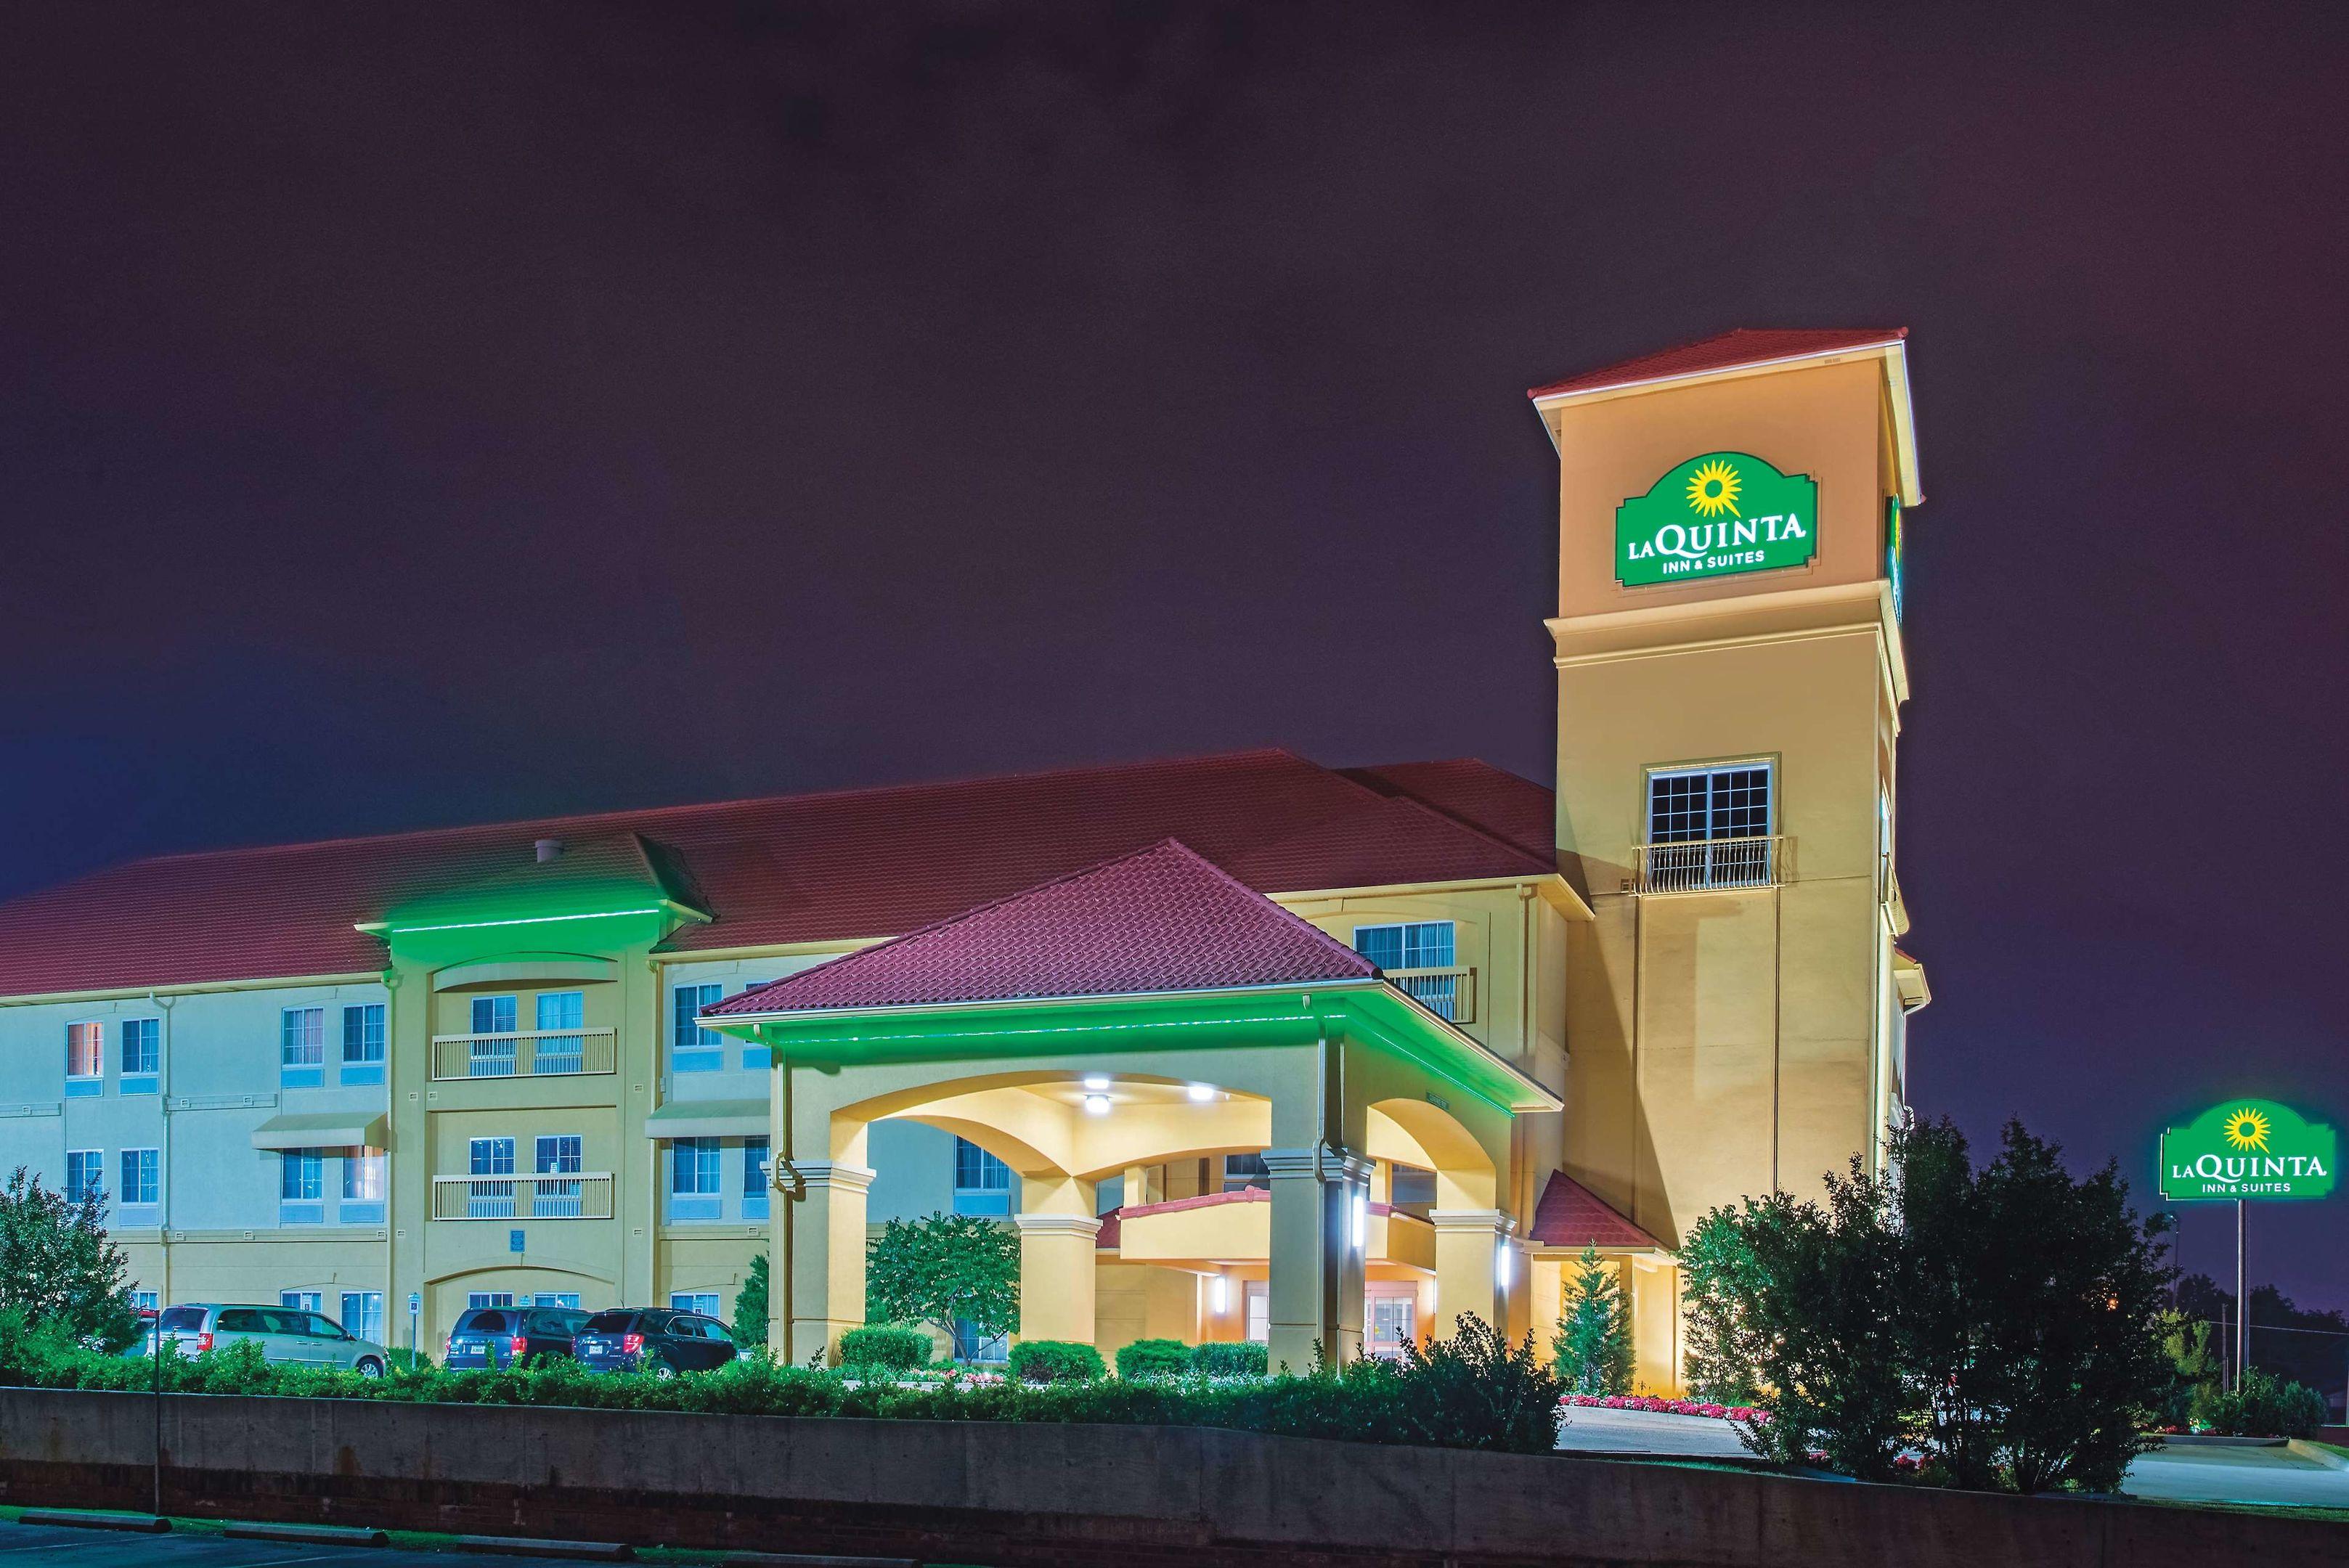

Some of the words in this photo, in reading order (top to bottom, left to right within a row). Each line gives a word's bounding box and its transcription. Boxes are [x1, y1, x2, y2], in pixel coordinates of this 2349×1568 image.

[1655, 513, 1807, 559] QUINTA
[1663, 560, 1690, 574] INN
[1694, 560, 1703, 570] &
[1707, 550, 1764, 568] SUITES
[2196, 1154, 2327, 1183] QUINTA
[2202, 1184, 2226, 1193] INN
[2242, 1183, 2291, 1192] SUITES
